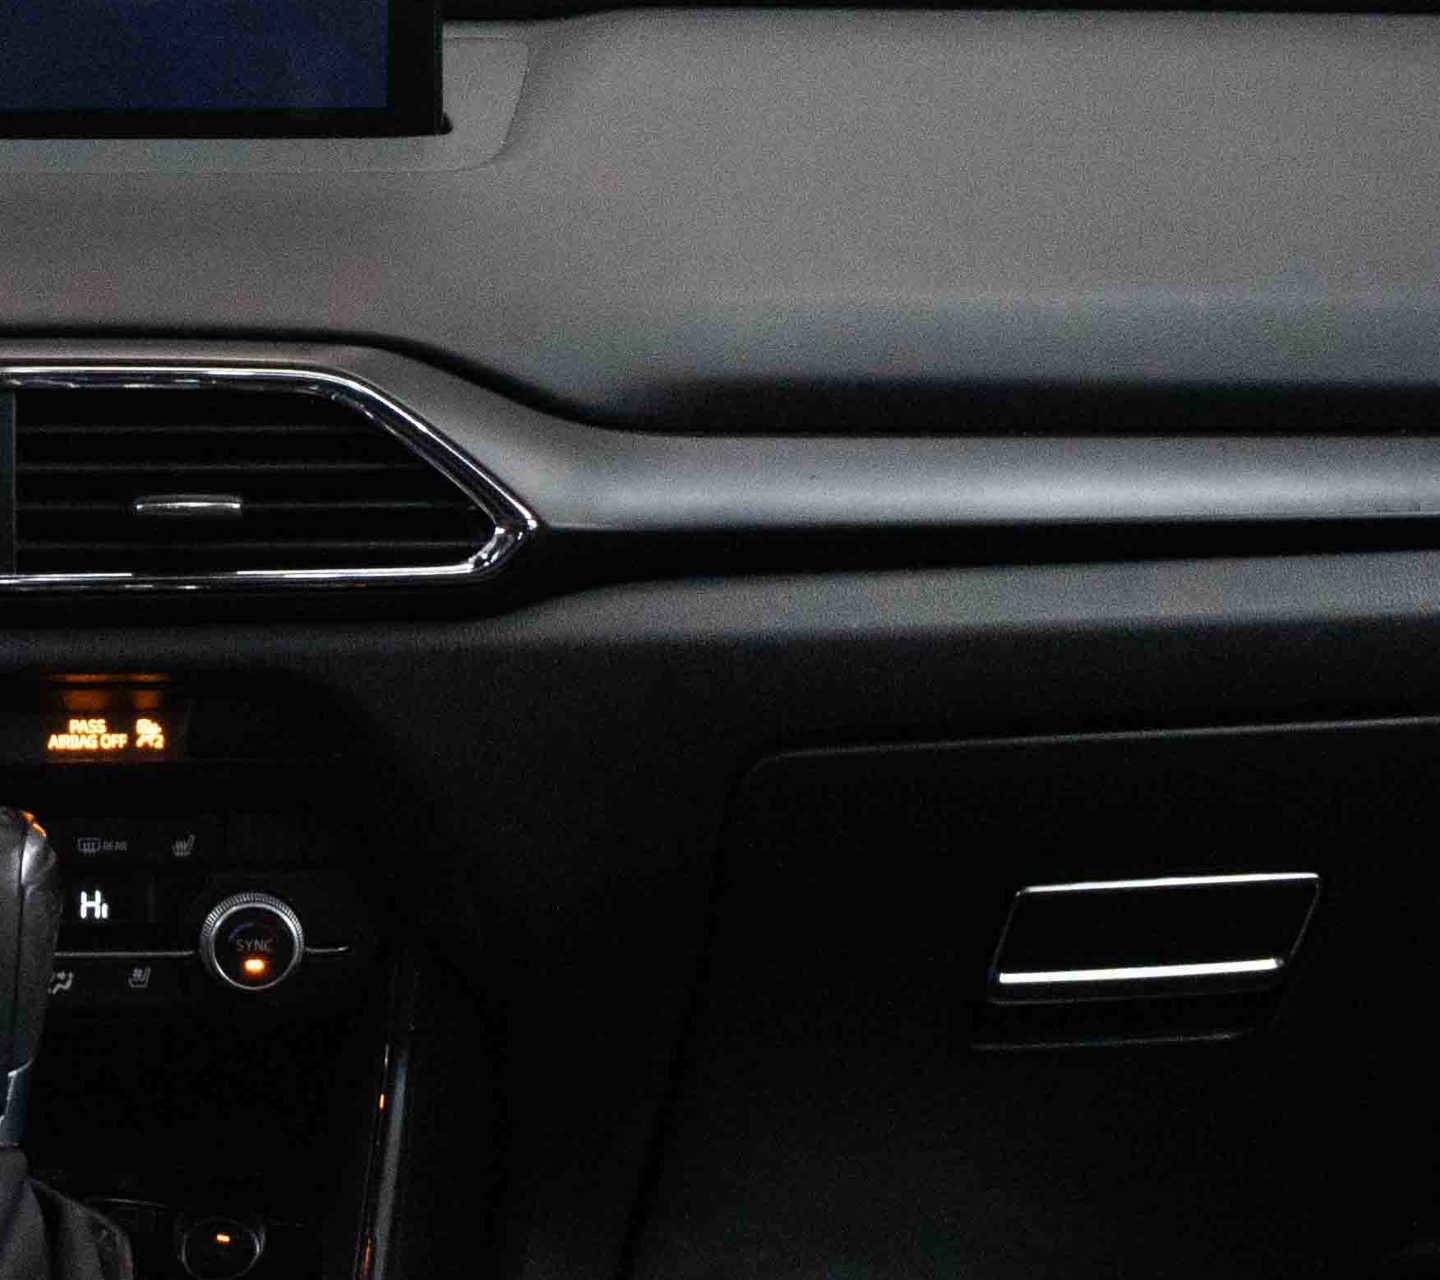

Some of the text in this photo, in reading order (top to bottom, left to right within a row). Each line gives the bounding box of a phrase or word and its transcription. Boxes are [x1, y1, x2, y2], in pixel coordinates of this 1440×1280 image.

[68, 718, 107, 734] PASS
[47, 733, 128, 749] AIRBAG OFF
[235, 938, 272, 952] SYNC
